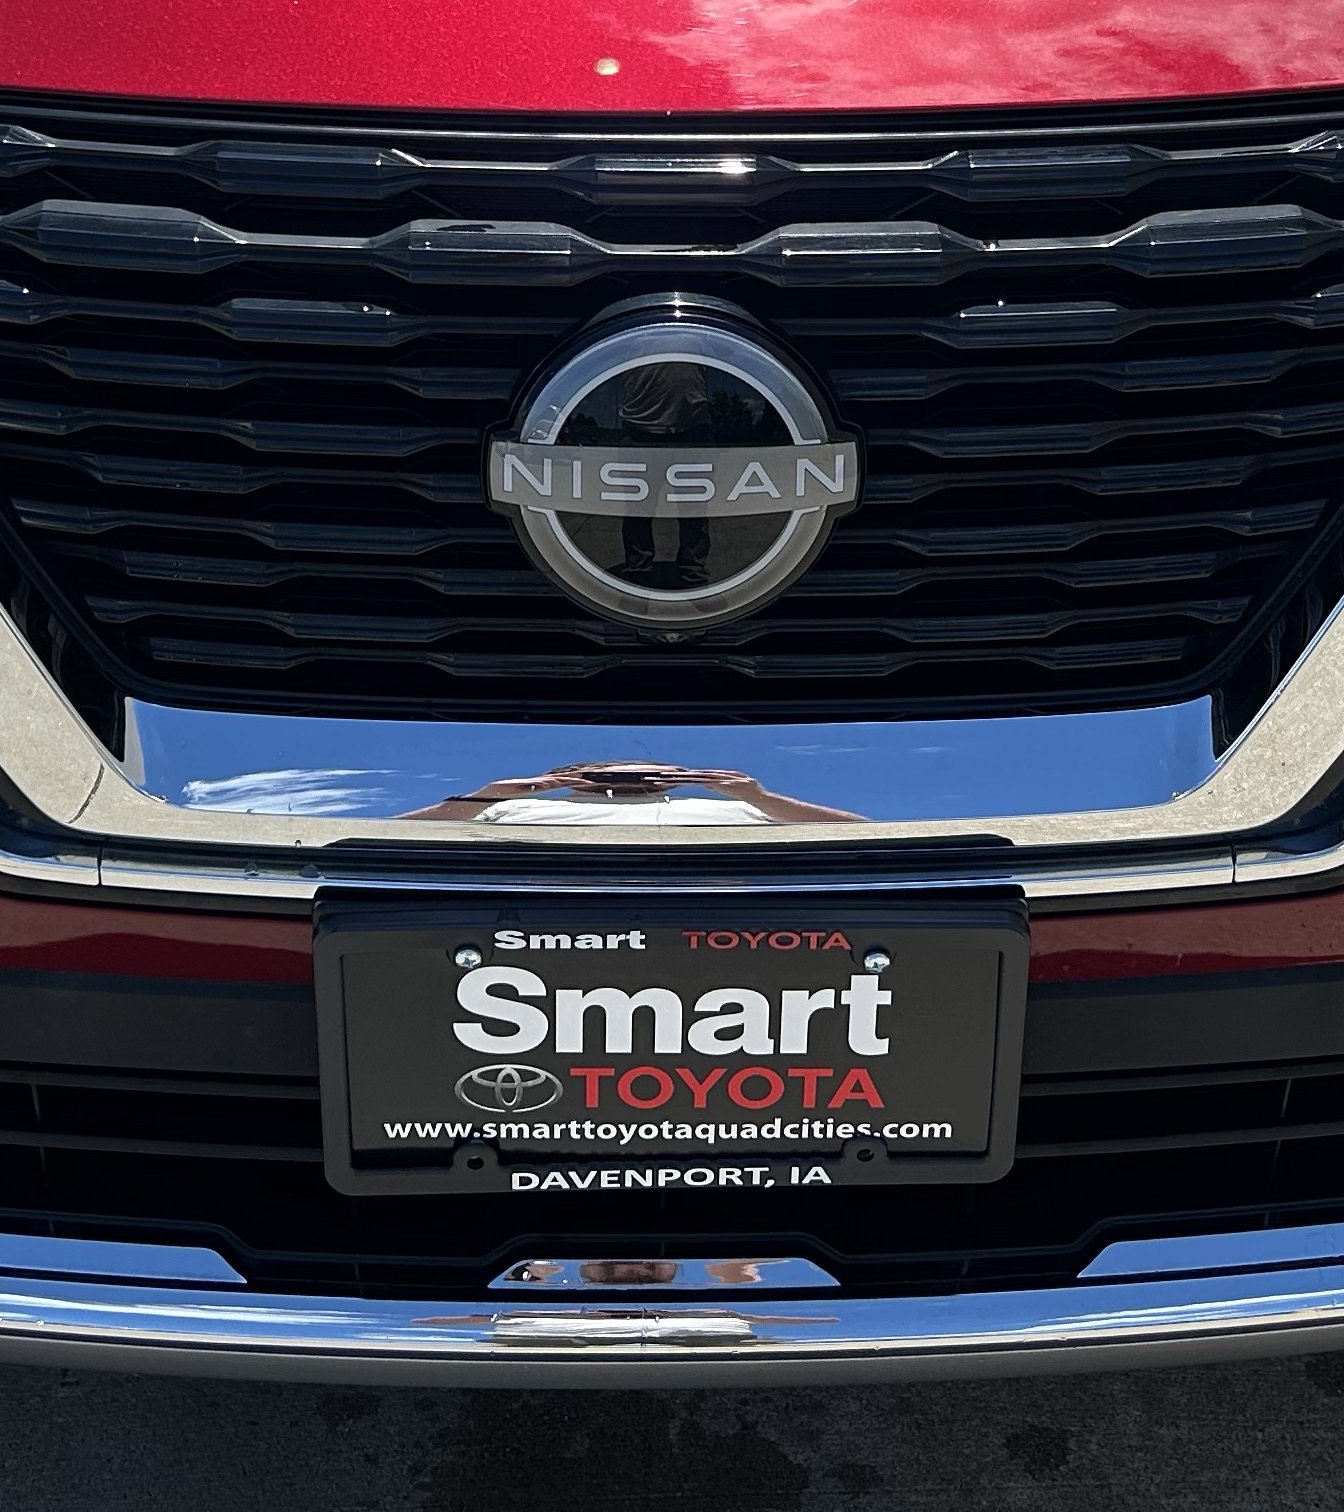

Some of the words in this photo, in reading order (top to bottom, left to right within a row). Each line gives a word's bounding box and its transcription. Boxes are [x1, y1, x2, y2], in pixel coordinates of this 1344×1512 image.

[502, 454, 845, 502] NISSAN
[494, 929, 647, 951] Smart
[682, 931, 852, 951] TOYOTA
[451, 965, 893, 1056] Smart
[570, 1066, 885, 1109] TOYOTA
[383, 1117, 953, 1146] www.smarttoyotaquadcities.com
[510, 1166, 776, 1192] DAVENPORT,
[790, 1164, 833, 1185] IA
